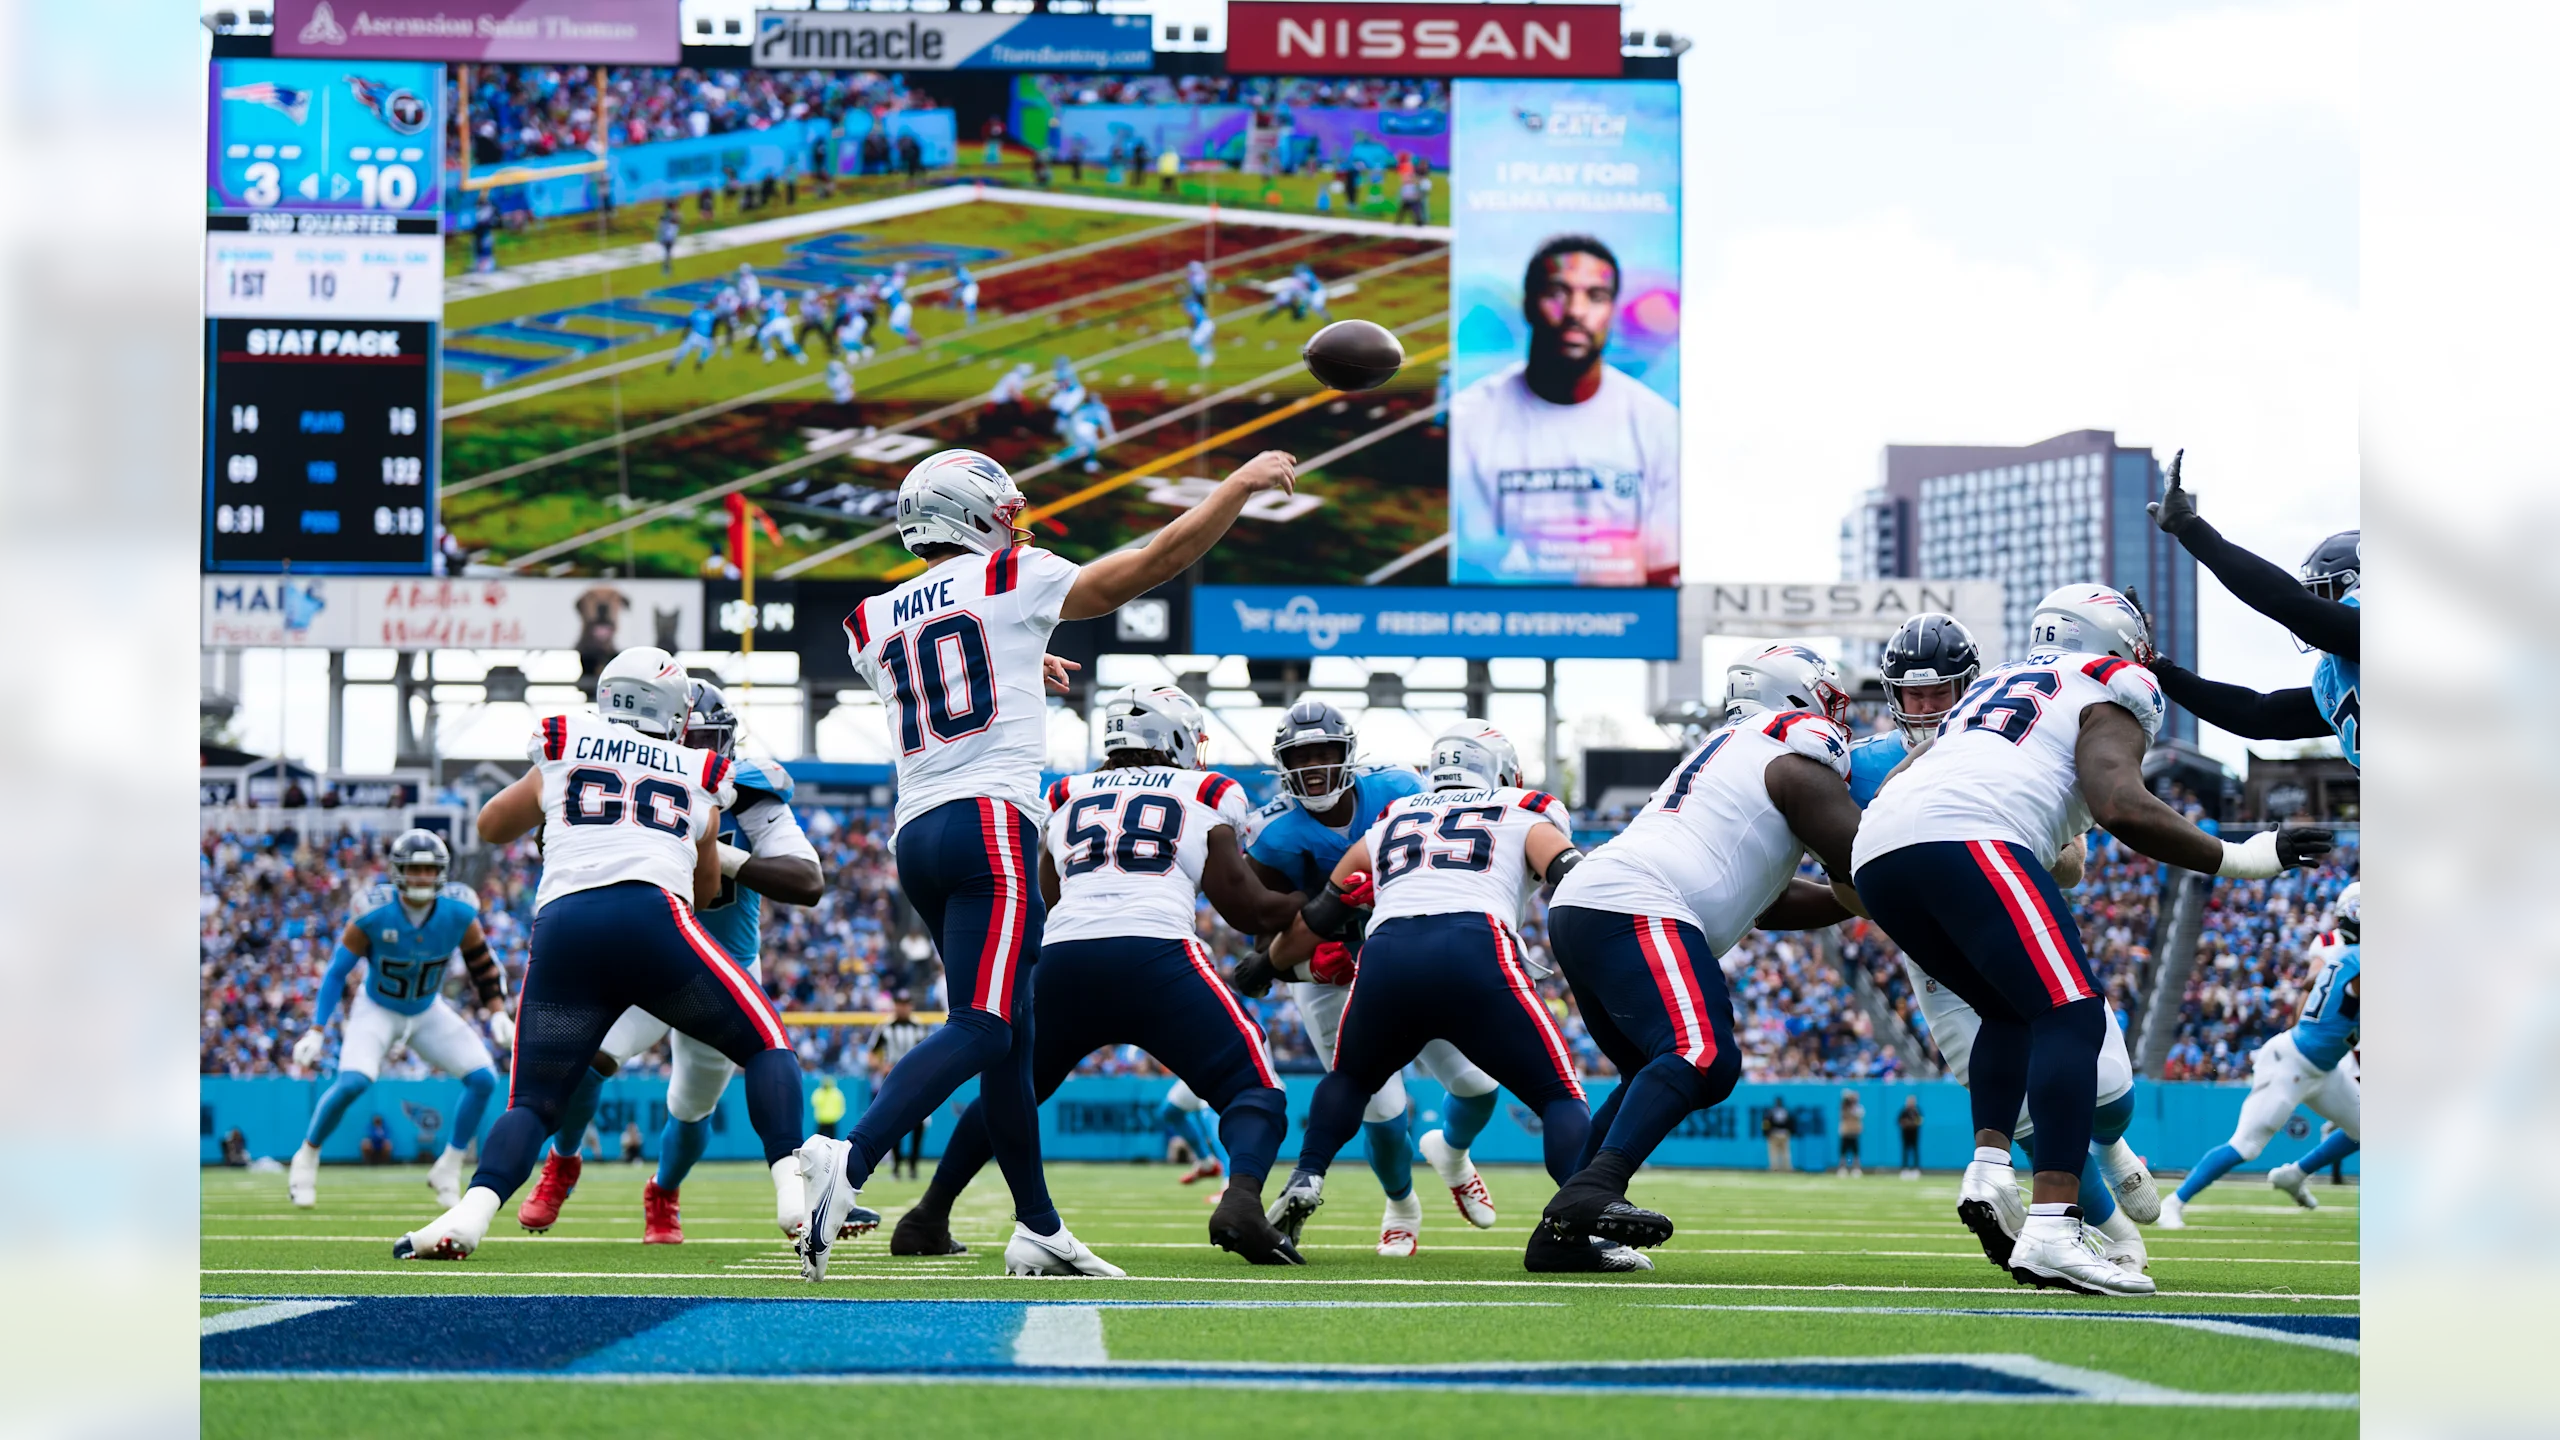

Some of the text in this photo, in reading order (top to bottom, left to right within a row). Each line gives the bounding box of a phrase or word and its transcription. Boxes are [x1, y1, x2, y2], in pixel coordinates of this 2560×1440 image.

[352, 11, 637, 40] Ascension Saint Thomas
[762, 18, 943, 61] Pinnacle
[1277, 18, 1571, 60] NISSAN
[243, 162, 417, 209] 3 10
[1510, 162, 1579, 185] PLAY
[1582, 163, 1640, 186] FOR
[248, 213, 397, 235] 2ND QUARTER
[230, 272, 265, 300] 1ST
[309, 272, 336, 300] 10
[389, 272, 401, 300] 7
[247, 329, 400, 357] STAT PACK
[231, 404, 259, 433] 14
[893, 577, 955, 628] MAYE
[1713, 585, 1956, 615] NISSAN
[1377, 611, 1450, 635] FRESH
[1452, 611, 1502, 636] FOR
[2035, 626, 2056, 642] 76
[878, 609, 999, 758] 10
[612, 693, 635, 709] 66
[1107, 719, 1124, 733] 58
[575, 736, 688, 777] CAMPBELL
[1439, 751, 1461, 765] 65
[1092, 773, 1175, 788] WILSON
[1433, 773, 1462, 783] PATRIOTS
[563, 765, 692, 841] 66
[1064, 790, 1187, 878] 58
[1377, 804, 1508, 890] 65
[378, 956, 448, 999] 50
